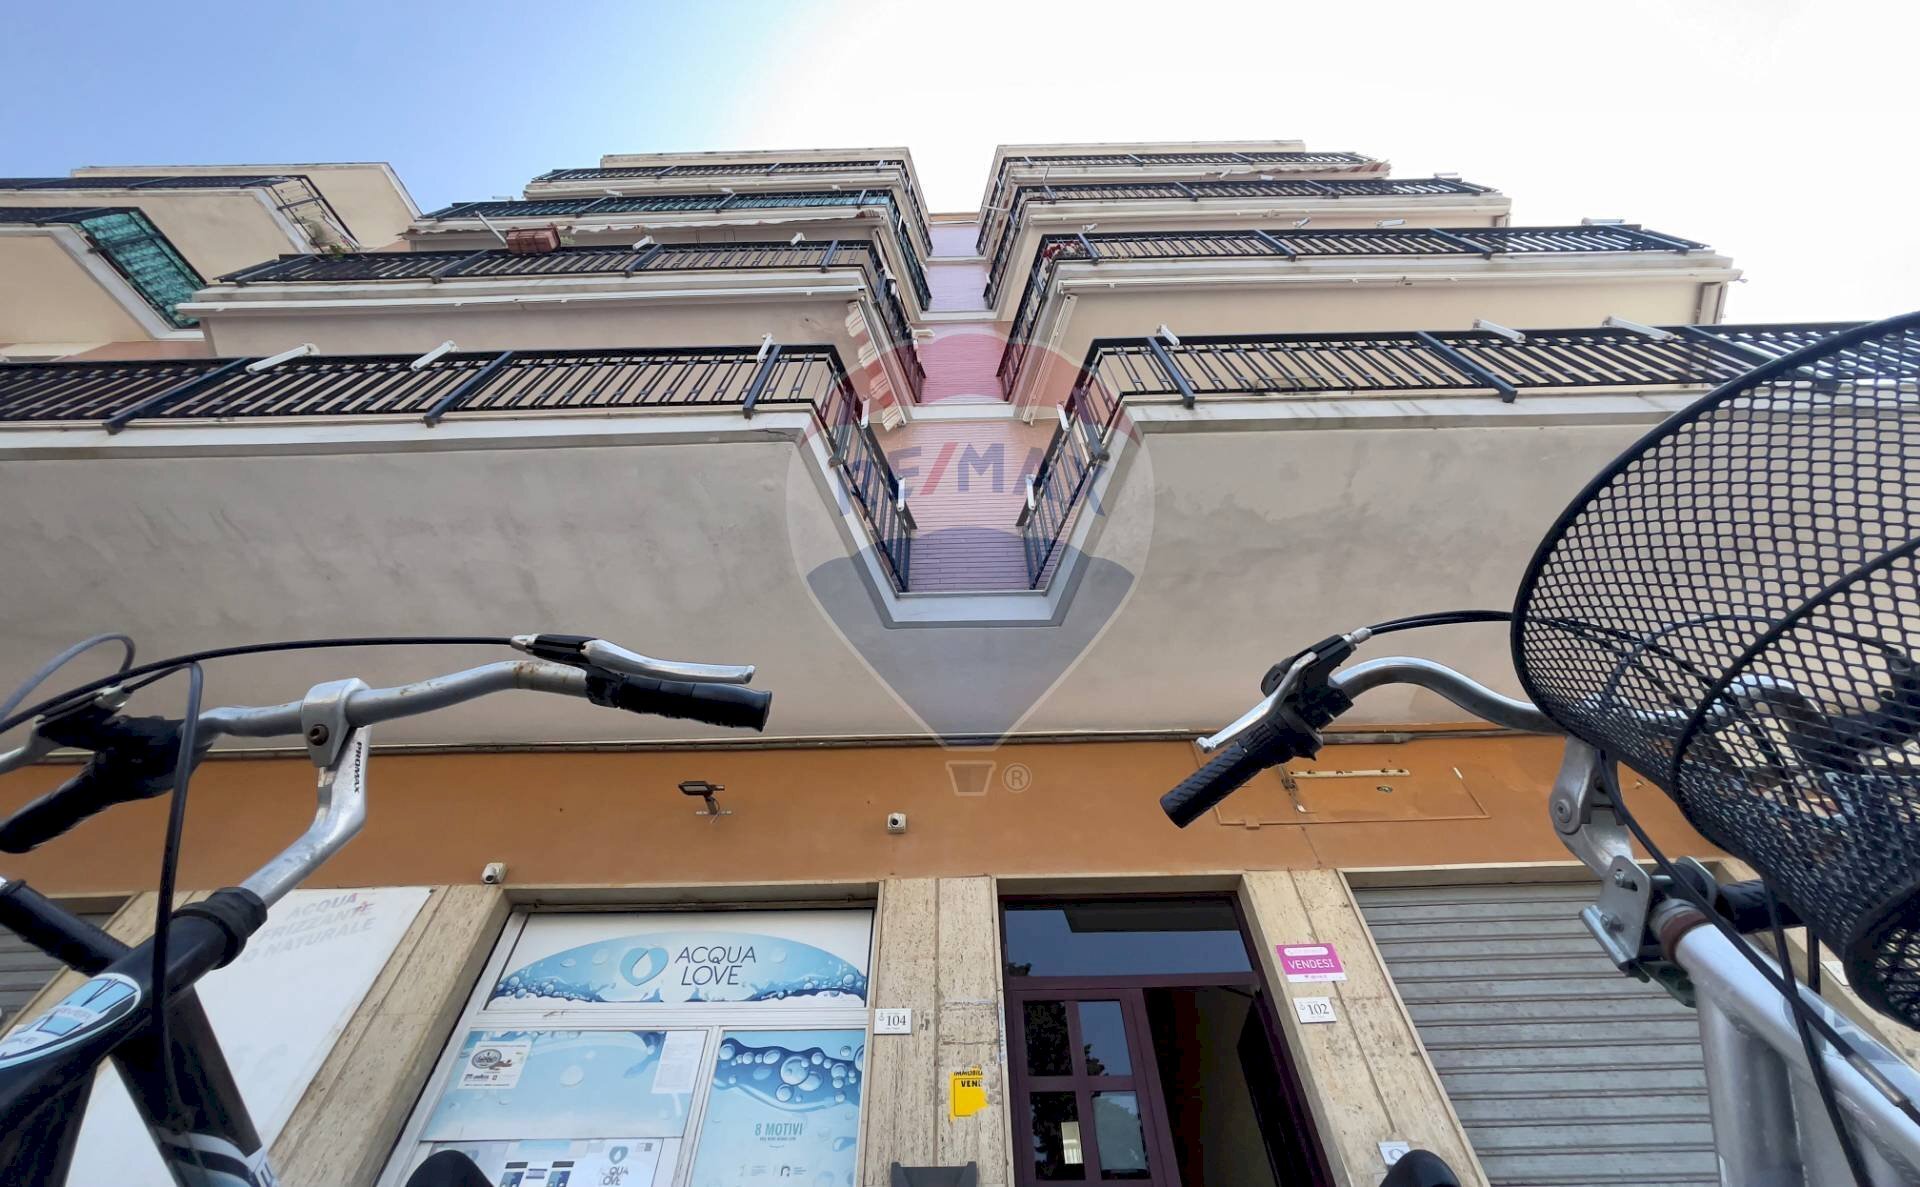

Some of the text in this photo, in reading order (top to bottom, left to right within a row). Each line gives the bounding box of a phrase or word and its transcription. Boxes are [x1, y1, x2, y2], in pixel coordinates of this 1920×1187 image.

[354, 741, 362, 794] PROMAX
[285, 892, 358, 920] ACQUA
[256, 902, 375, 942] FRIZZANTE
[263, 917, 376, 958] NATURALE
[674, 946, 757, 965] ACQUA
[1287, 958, 1335, 969] VENDESI
[681, 965, 743, 986] LOVE
[1307, 1003, 1330, 1015] 102
[887, 1015, 906, 1026] 104
[754, 1123, 803, 1136] 8 MOTIVI
